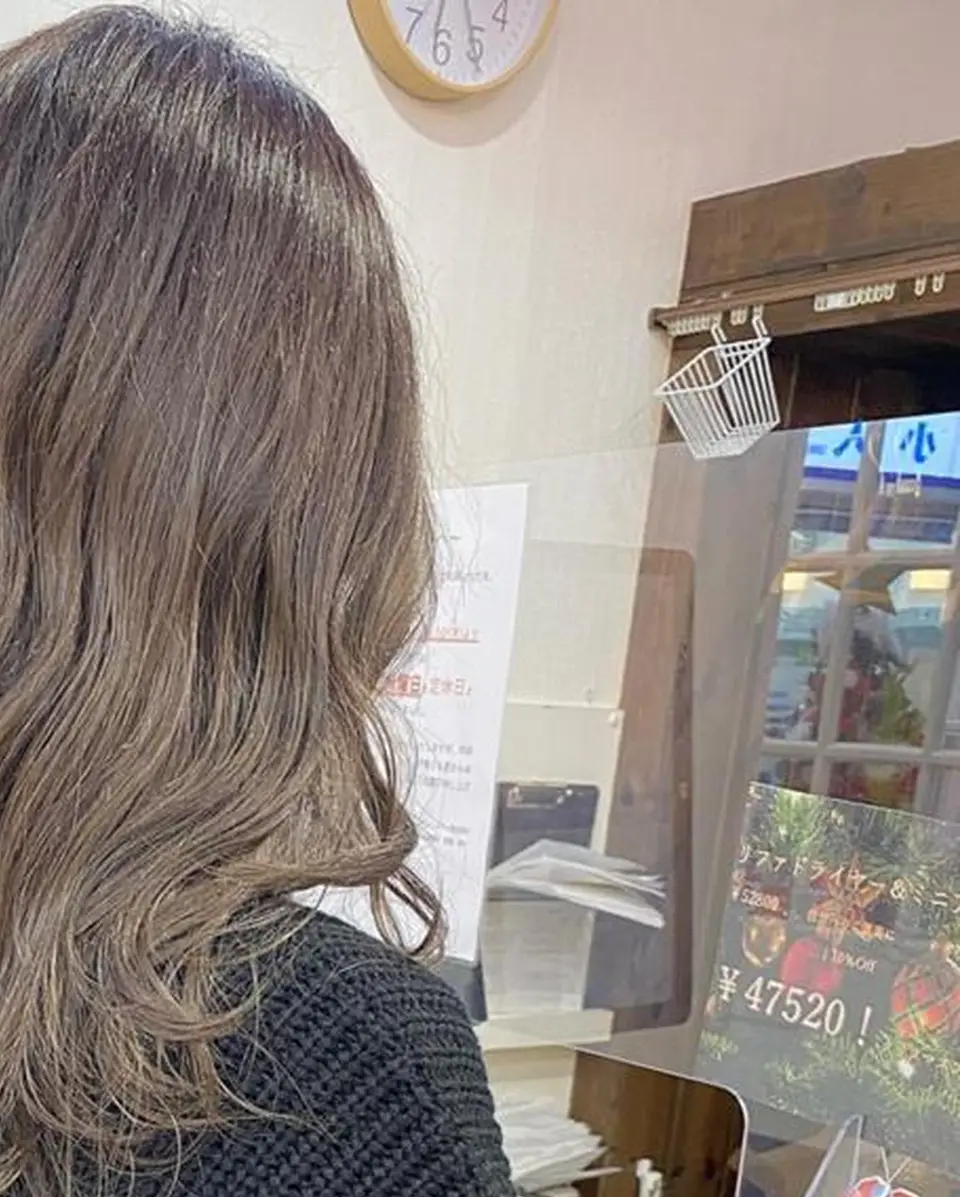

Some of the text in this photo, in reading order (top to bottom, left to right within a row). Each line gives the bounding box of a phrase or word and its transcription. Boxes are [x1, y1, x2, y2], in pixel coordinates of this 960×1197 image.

[406, 6, 423, 44] 7
[492, 0, 508, 32] 4
[433, 27, 452, 66] 6
[466, 25, 485, 63] 5
